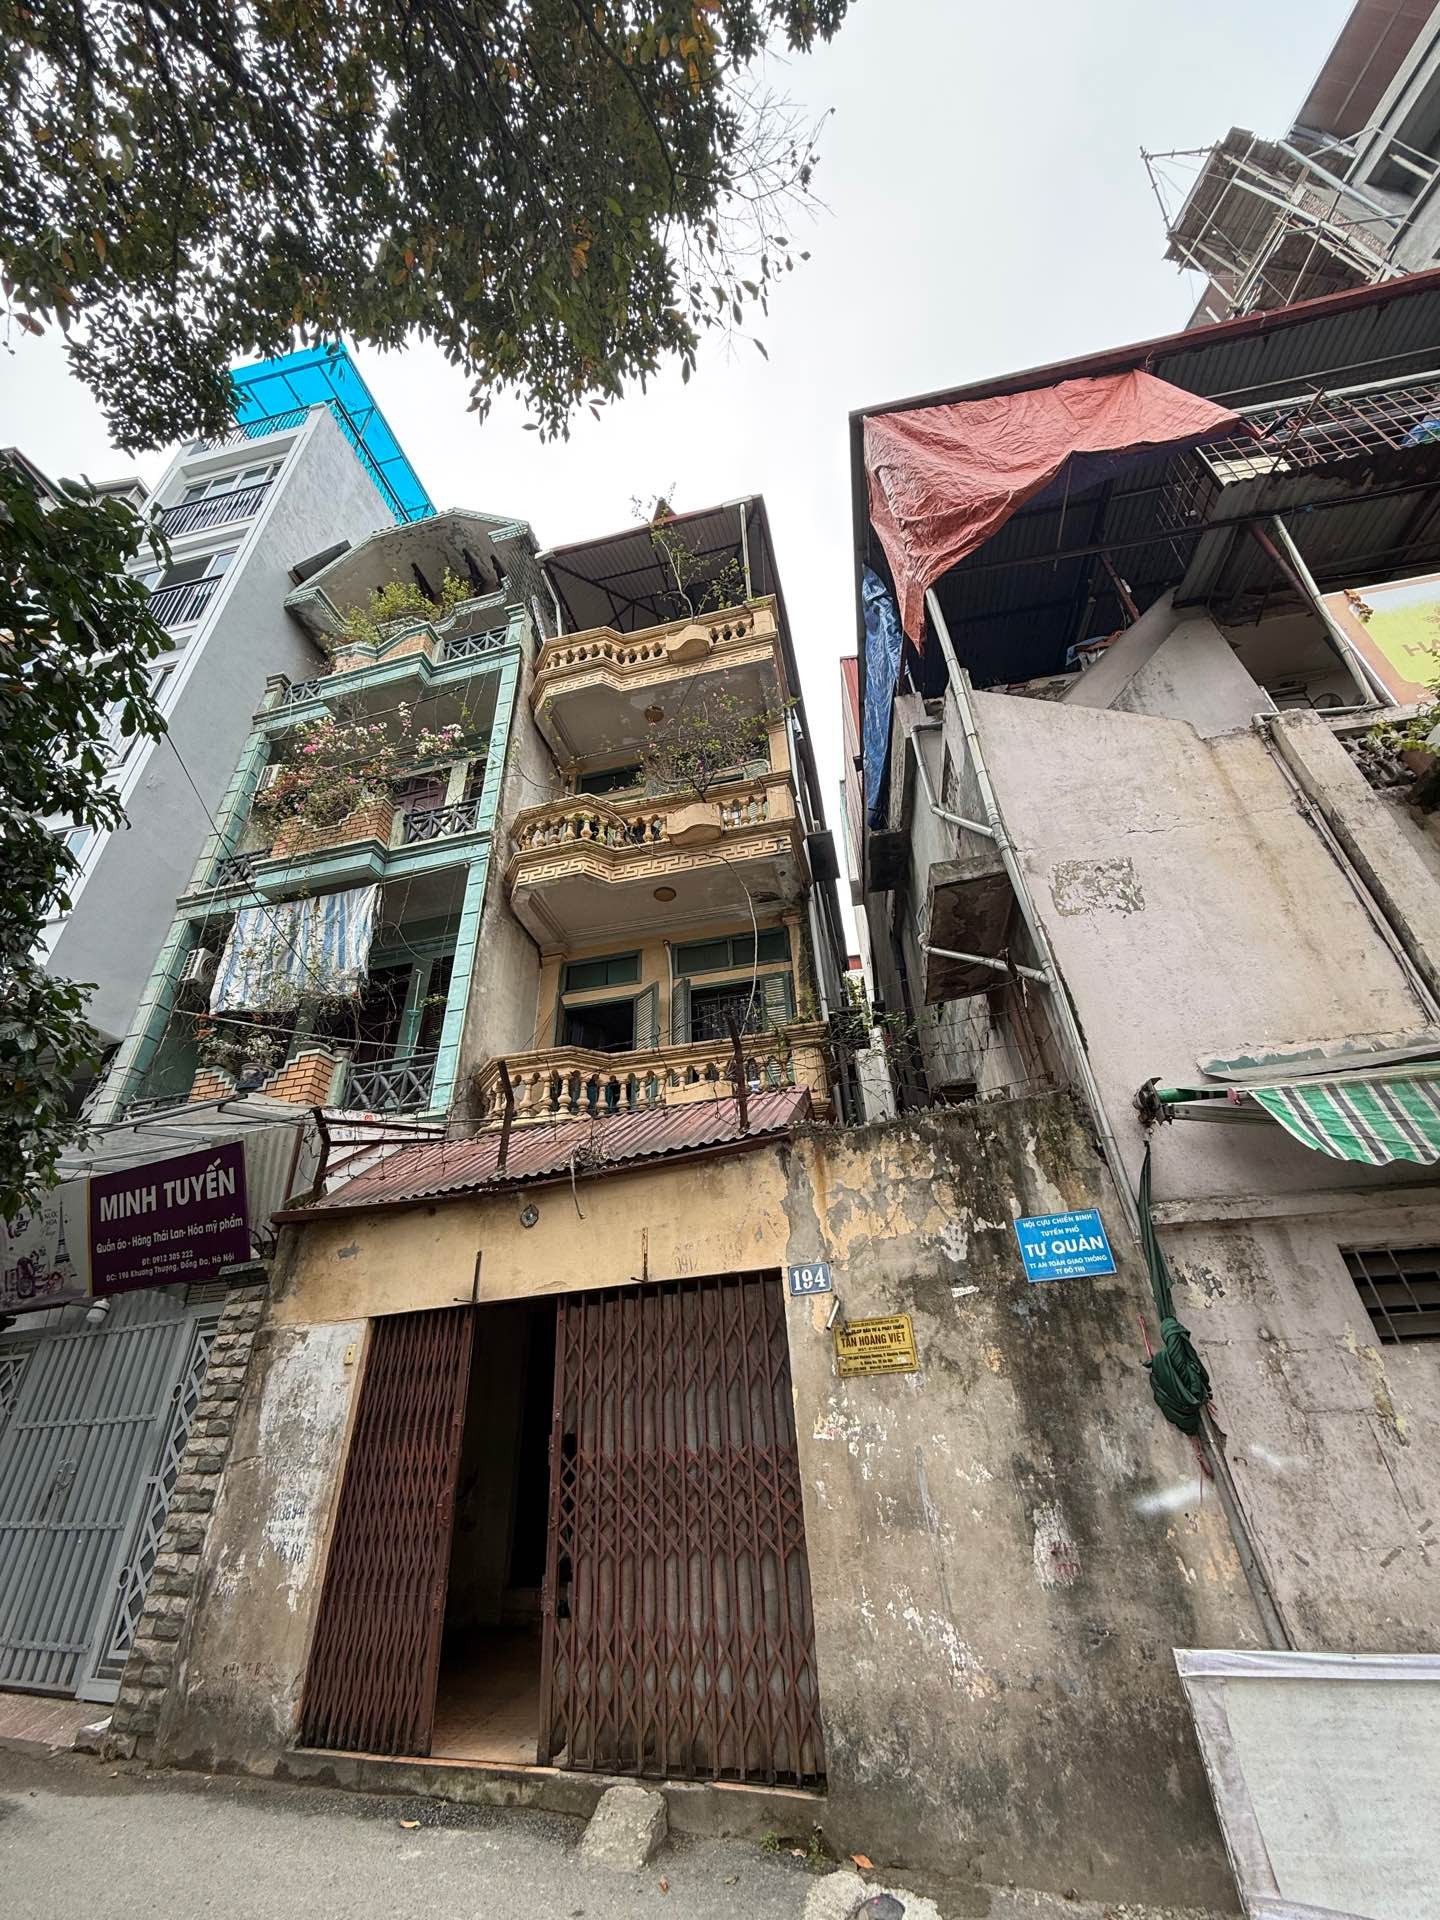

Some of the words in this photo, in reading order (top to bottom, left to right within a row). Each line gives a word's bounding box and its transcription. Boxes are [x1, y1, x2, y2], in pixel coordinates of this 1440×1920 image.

[100, 1185, 157, 1222] MINH
[163, 1158, 236, 1208] TUYẾN
[1075, 1213, 1093, 1221] BINH
[1024, 1240, 1047, 1260] TỰ
[1051, 1233, 1104, 1255] QUẢN
[793, 1266, 827, 1291] 194
